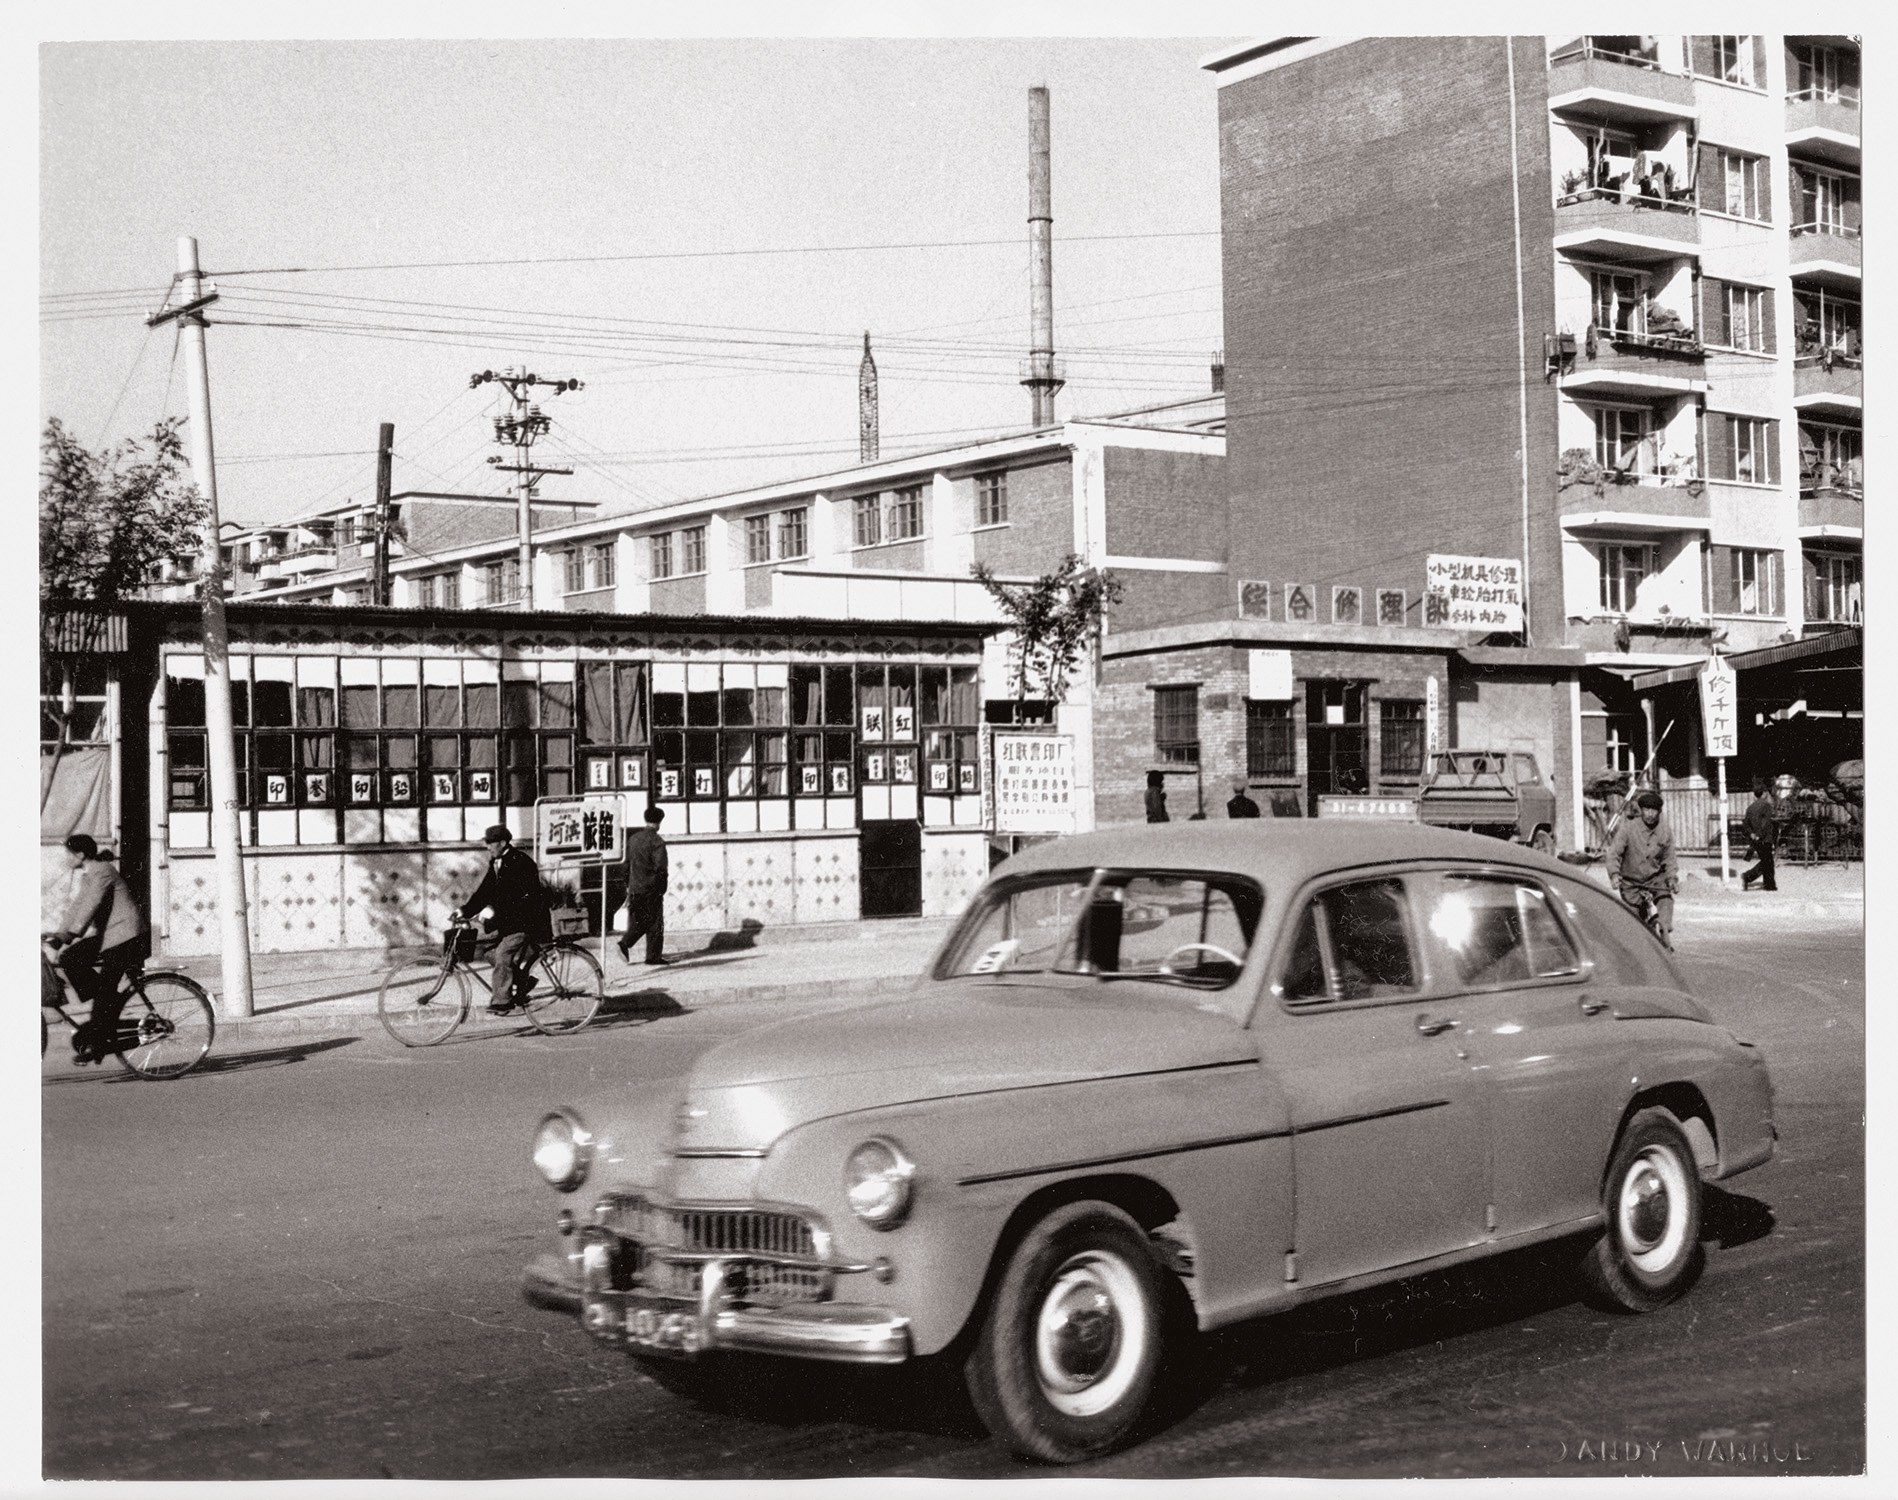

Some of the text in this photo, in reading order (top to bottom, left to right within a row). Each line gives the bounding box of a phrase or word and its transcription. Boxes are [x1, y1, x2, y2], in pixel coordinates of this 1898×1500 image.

[1708, 675, 1734, 750] 修千斤顶
[664, 774, 677, 793] 字
[696, 773, 711, 792] 打
